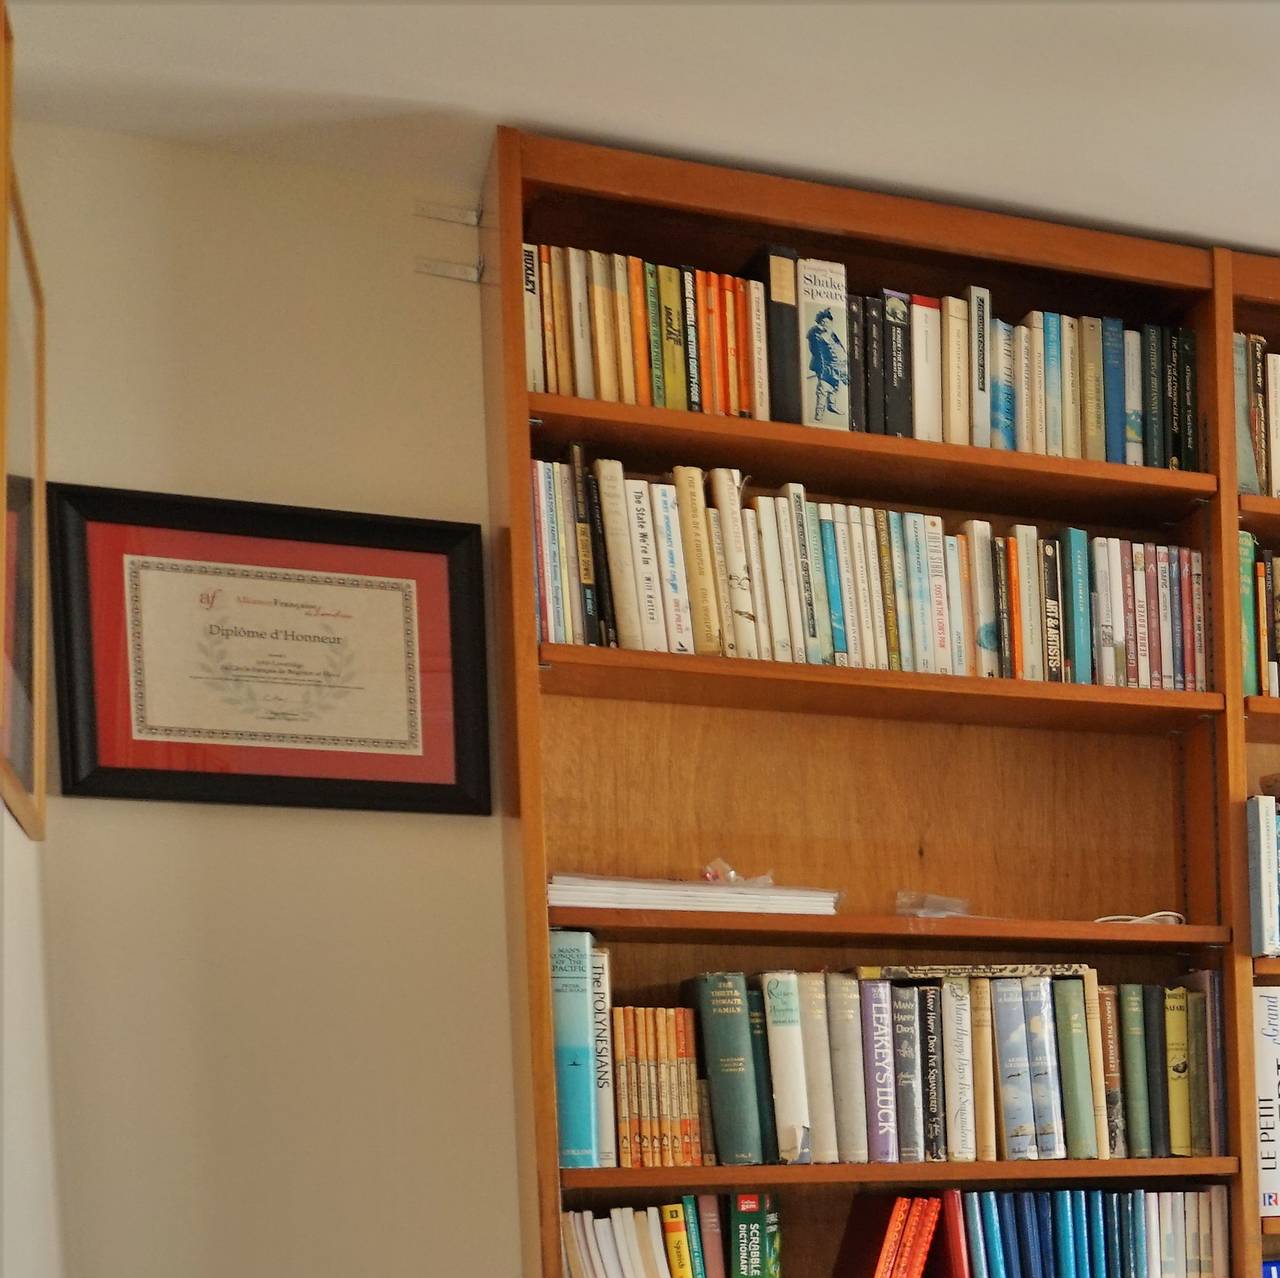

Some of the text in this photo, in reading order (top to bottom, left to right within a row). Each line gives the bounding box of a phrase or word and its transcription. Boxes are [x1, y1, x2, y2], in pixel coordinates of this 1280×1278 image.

[524, 250, 536, 295] HUXLEY
[664, 306, 673, 342] JACKAL
[633, 491, 644, 504] The
[636, 507, 647, 529] State
[639, 532, 648, 554] We're
[642, 557, 650, 565] In
[209, 624, 343, 645] Diplôme d'Honneur
[1046, 599, 1060, 667] ART & ARTISTS
[592, 964, 610, 1088] The POLYNESIANS
[955, 1001, 967, 1028] Many
[1260, 994, 1279, 1043] Grand
[952, 1027, 969, 1056] Happy
[872, 1003, 895, 1135] LEAKEY'S LUCK
[928, 1069, 938, 1112] SQUANDERED
[955, 1098, 971, 1152] Squandered
[1258, 1097, 1276, 1170] LE PETIT
[738, 1224, 749, 1276] DICTIONARY
[749, 1223, 762, 1277] SCRABBLE
